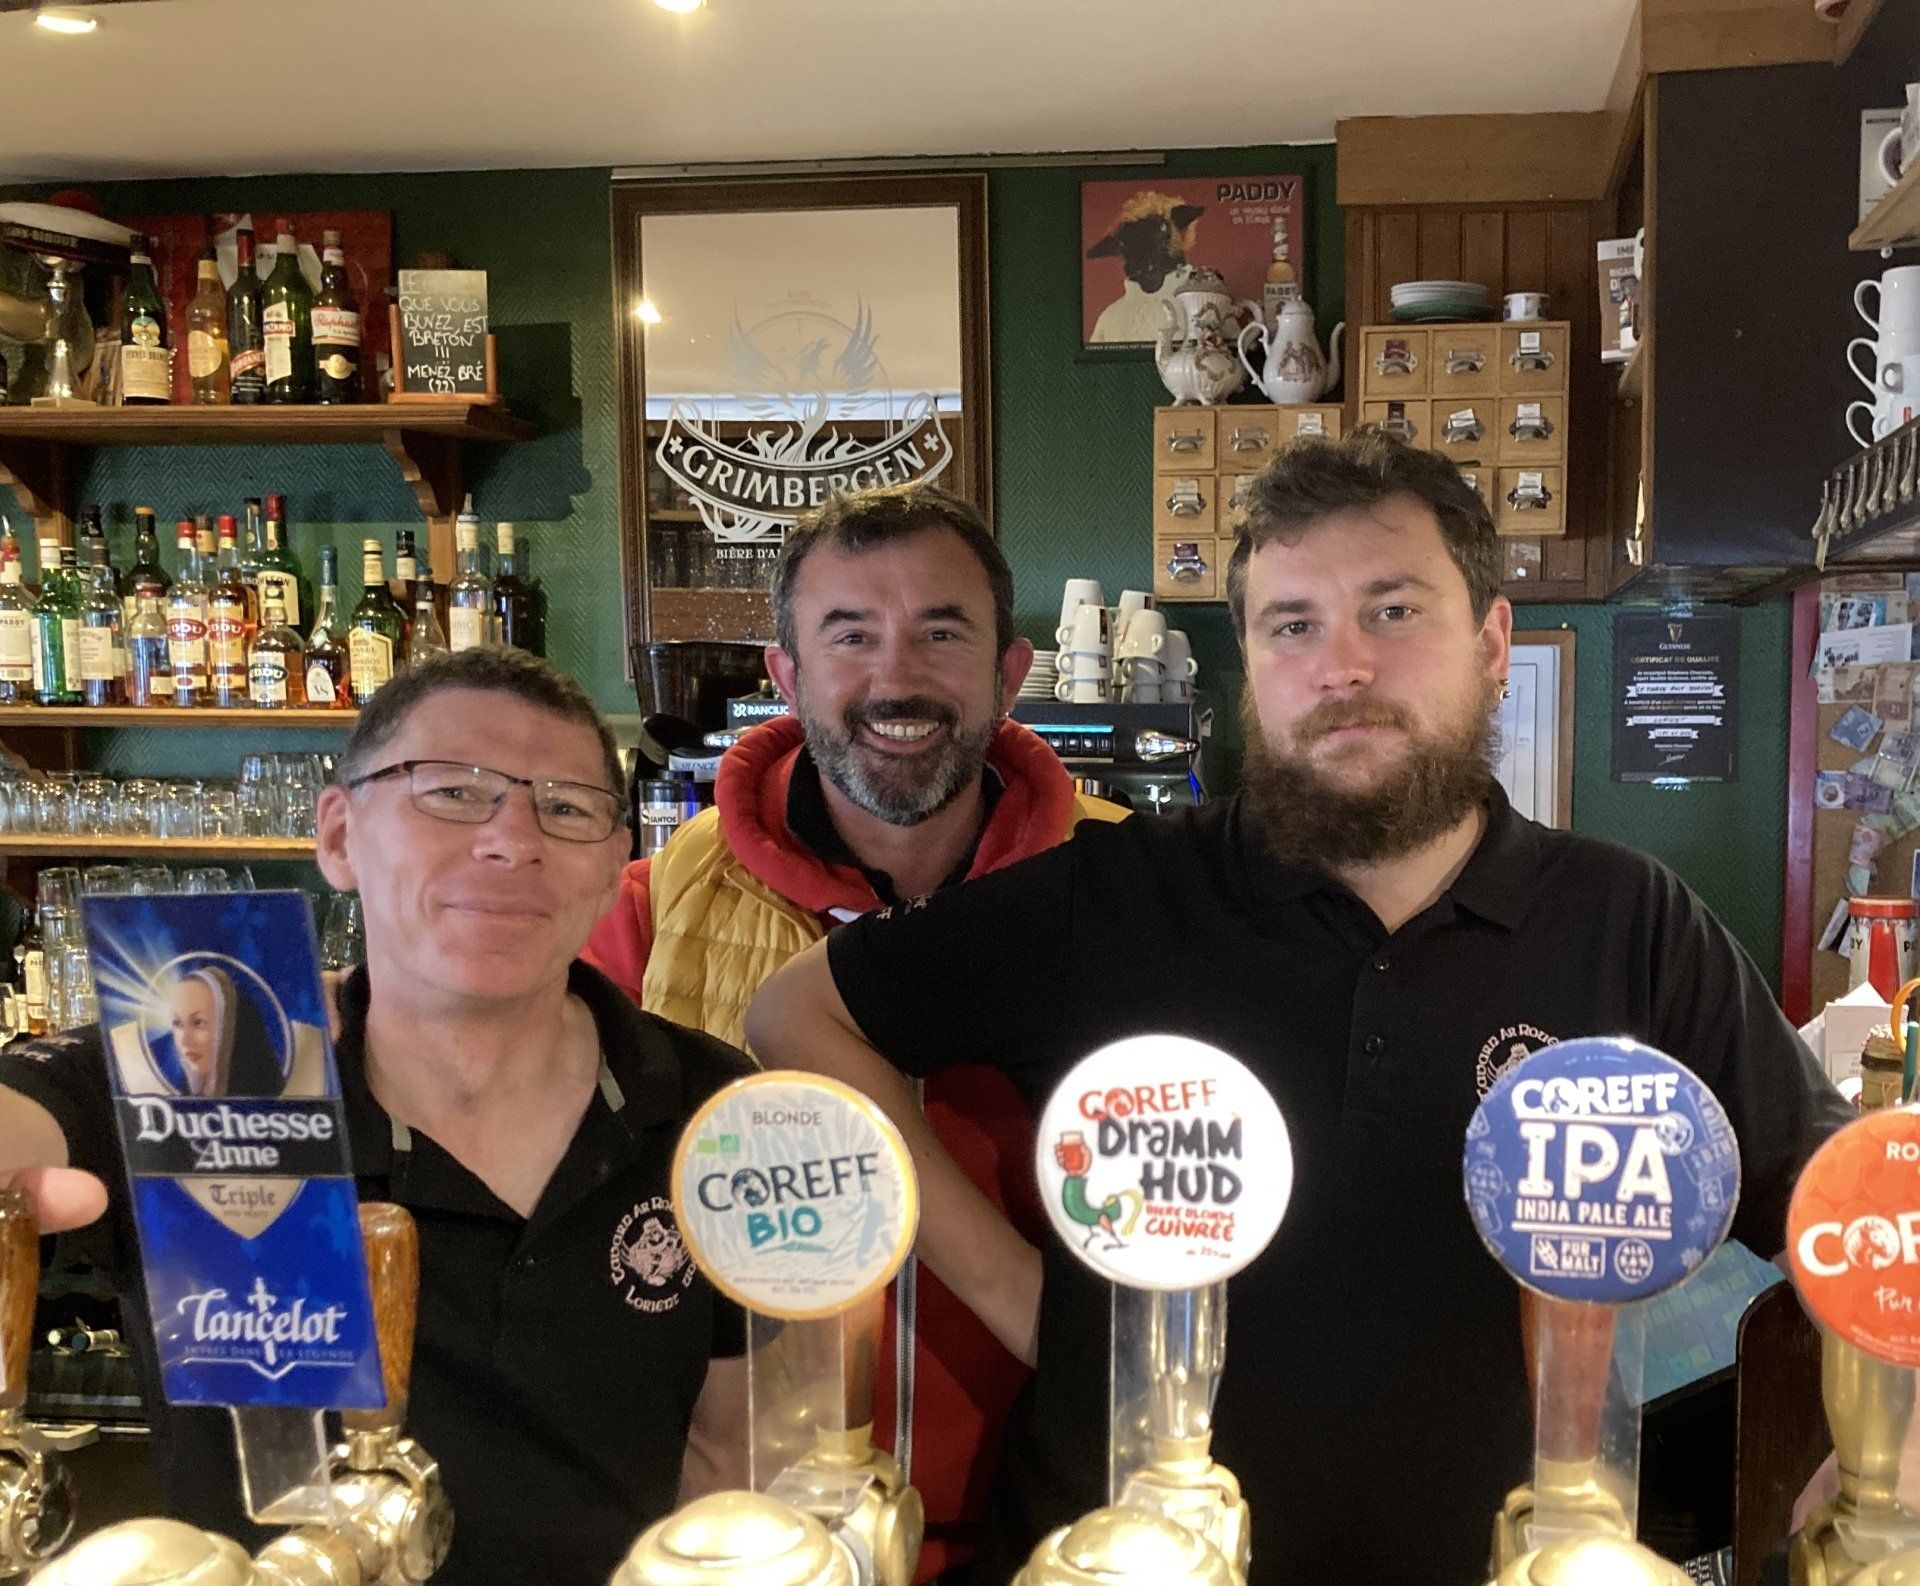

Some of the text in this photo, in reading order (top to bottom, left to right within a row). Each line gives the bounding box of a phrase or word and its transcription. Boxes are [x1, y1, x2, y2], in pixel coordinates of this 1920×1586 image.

[1217, 183, 1297, 203] PADDY
[399, 296, 481, 313] QUE VOUS
[404, 312, 488, 334] BUVEZ EST
[407, 360, 483, 381] MENEZ BRÉ
[682, 441, 927, 508] GRIMBERGEN
[716, 546, 753, 559] BIÈRE
[681, 761, 715, 769] SILENCE
[1078, 1079, 1216, 1121] COREFF
[1512, 1072, 1680, 1115] COREFF
[127, 1096, 334, 1142] Duchesse
[753, 1110, 823, 1126] BLONDE
[190, 1139, 280, 1170] Anne
[1517, 1121, 1673, 1205] IPA
[208, 1183, 277, 1209] Triple
[698, 1152, 878, 1212] COREFF
[1139, 1158, 1243, 1206] HUD
[747, 1206, 823, 1248] BIO
[1515, 1198, 1673, 1228] INDIA PALE ALE
[1561, 1240, 1591, 1254] PUR
[1560, 1254, 1600, 1273] MALT
[1874, 1284, 1913, 1315] Pur
[177, 1288, 348, 1344] Lancelot
